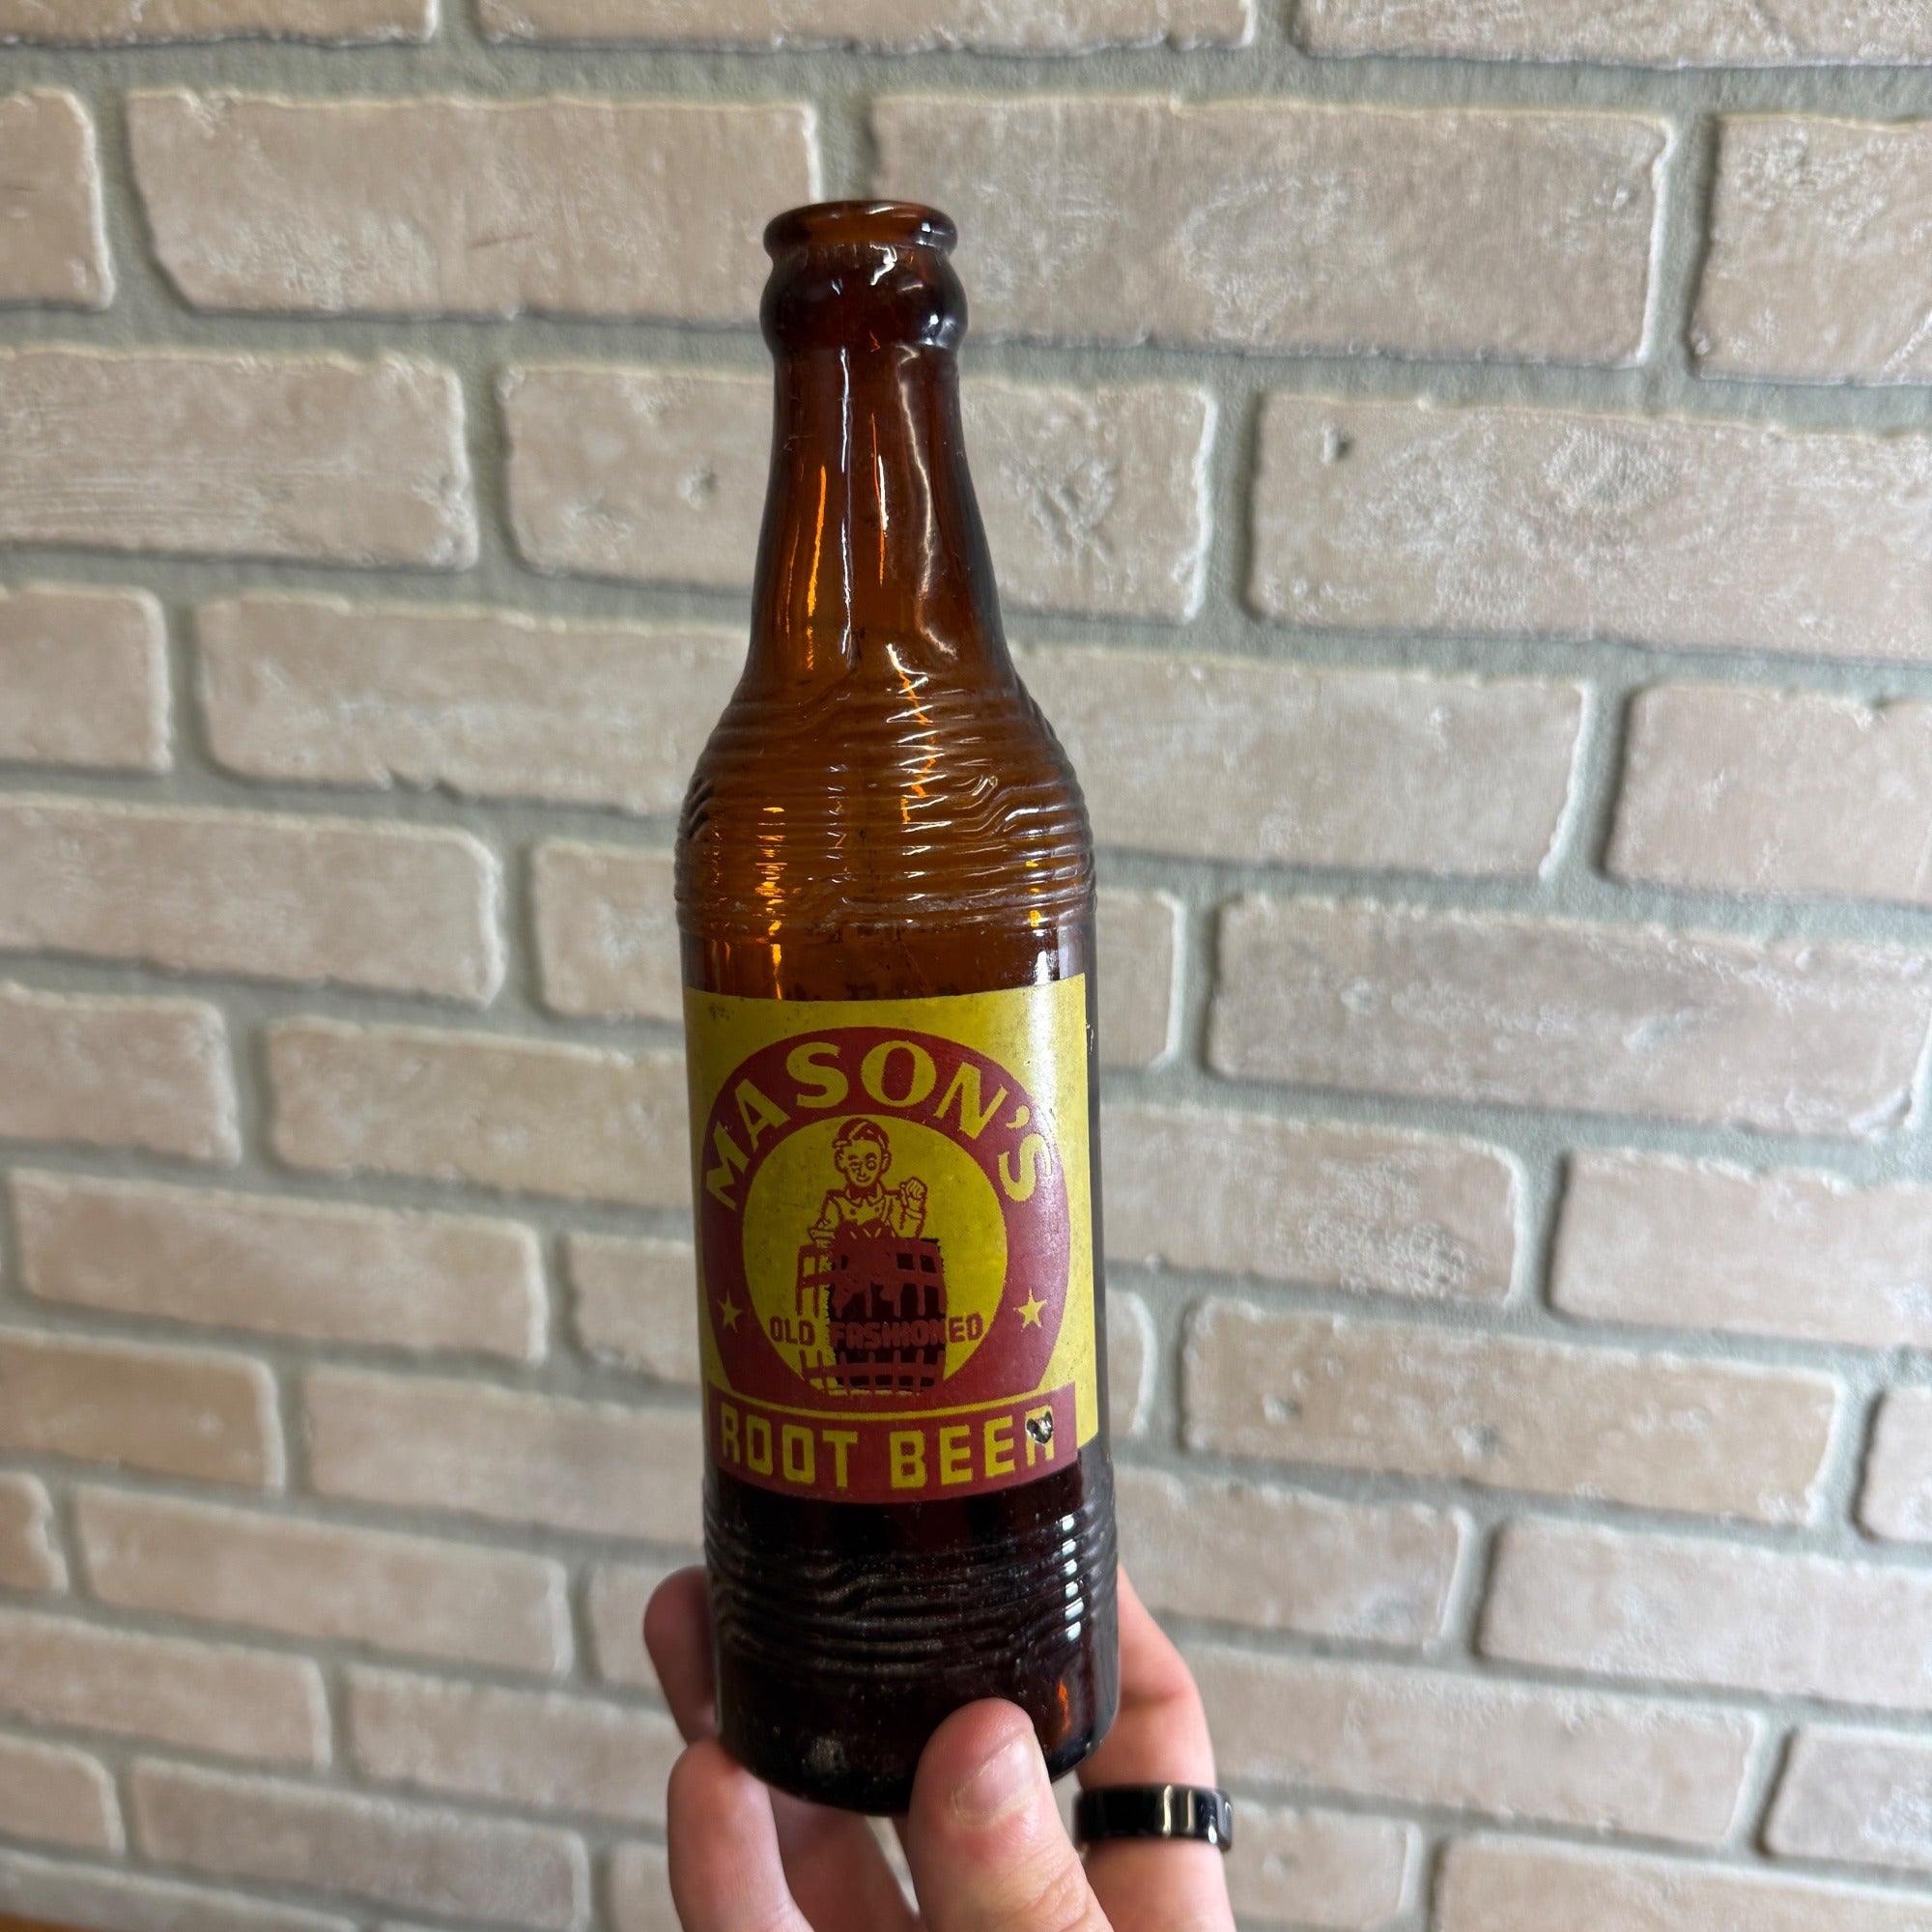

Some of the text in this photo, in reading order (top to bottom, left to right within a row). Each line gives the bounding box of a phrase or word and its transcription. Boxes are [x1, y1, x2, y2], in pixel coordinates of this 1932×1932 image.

[706, 1040, 1053, 1210] MASON'S
[771, 1313, 983, 1350] OLD FASHIONED
[720, 1402, 1055, 1490] ROOT BEER
